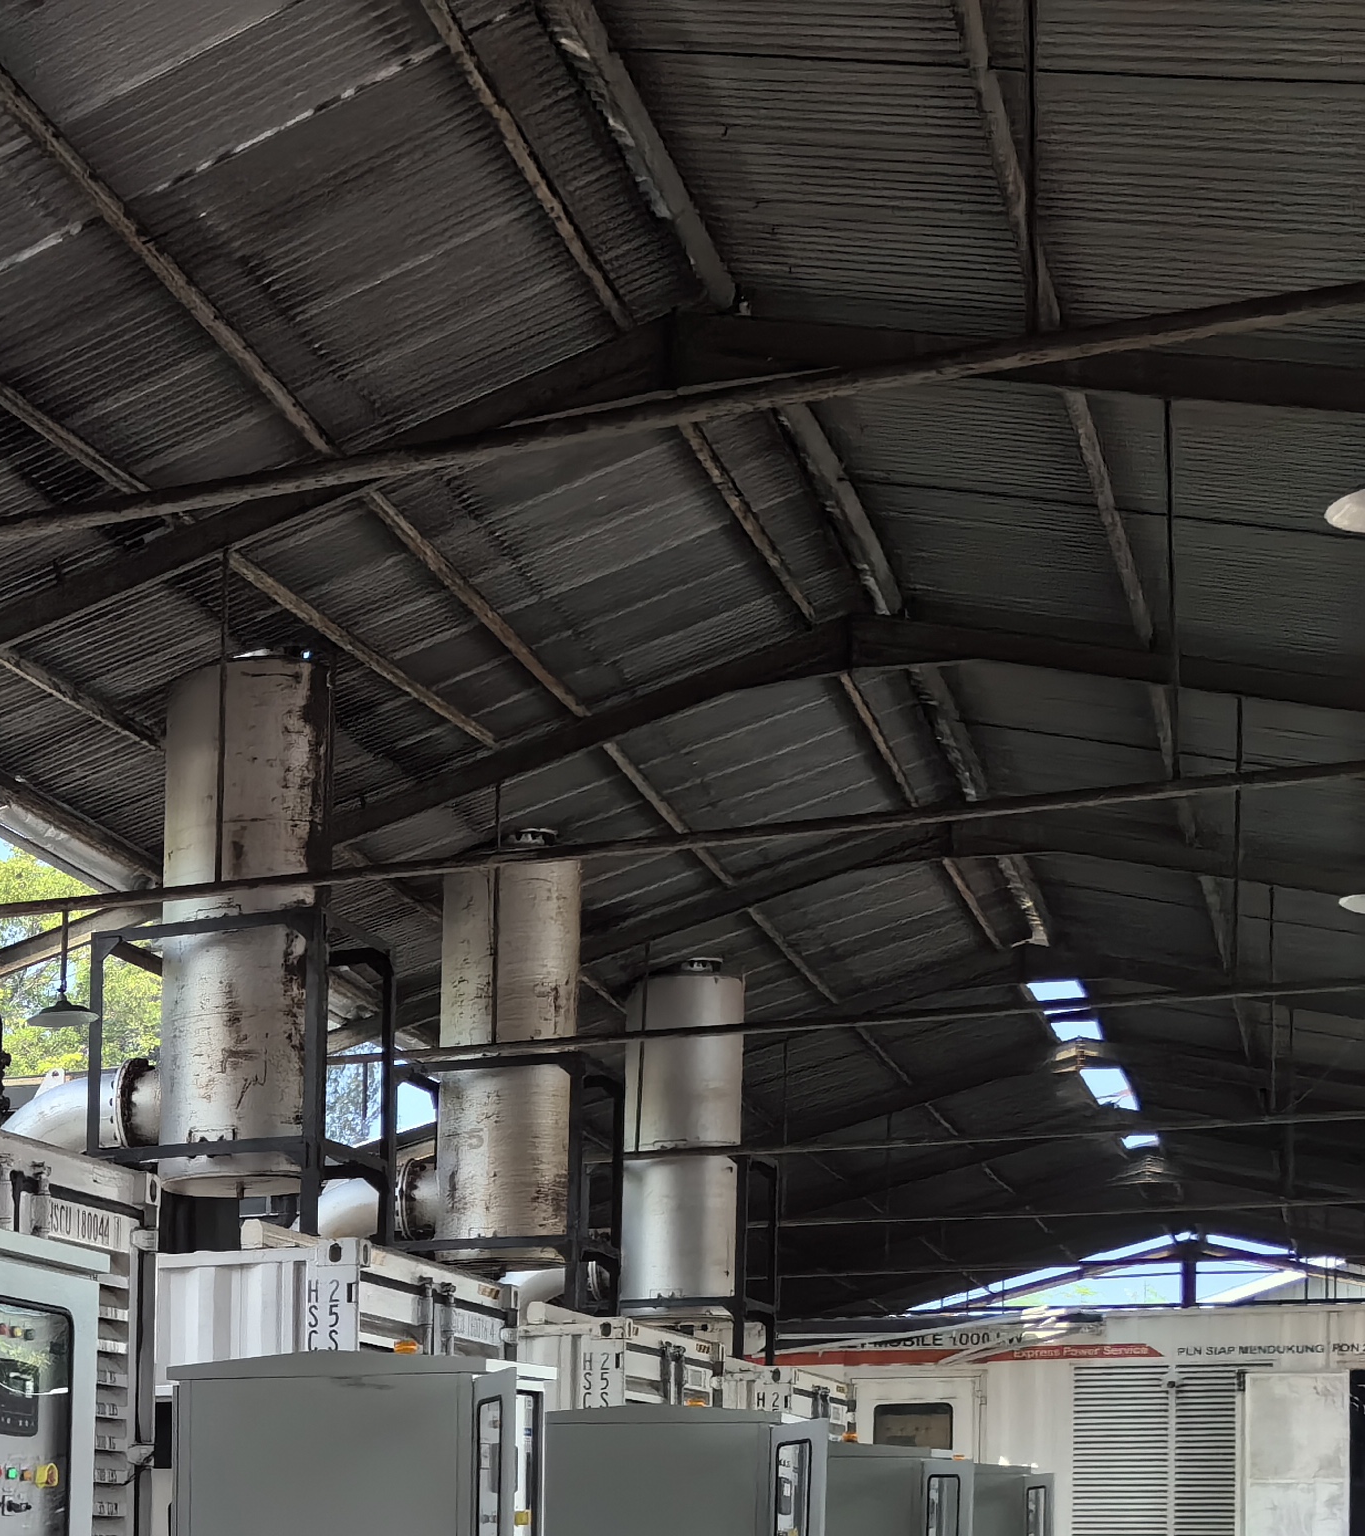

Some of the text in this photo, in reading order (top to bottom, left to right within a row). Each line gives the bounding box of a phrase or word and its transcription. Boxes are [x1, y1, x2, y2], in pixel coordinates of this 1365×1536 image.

[77, 1208, 110, 1246] 180044
[1013, 1345, 1149, 1359] Express Power Service
[1177, 1346, 1202, 1356] PLN
[1206, 1345, 1235, 1356] SIAP
[1238, 1344, 1325, 1355] MENDUKUNG
